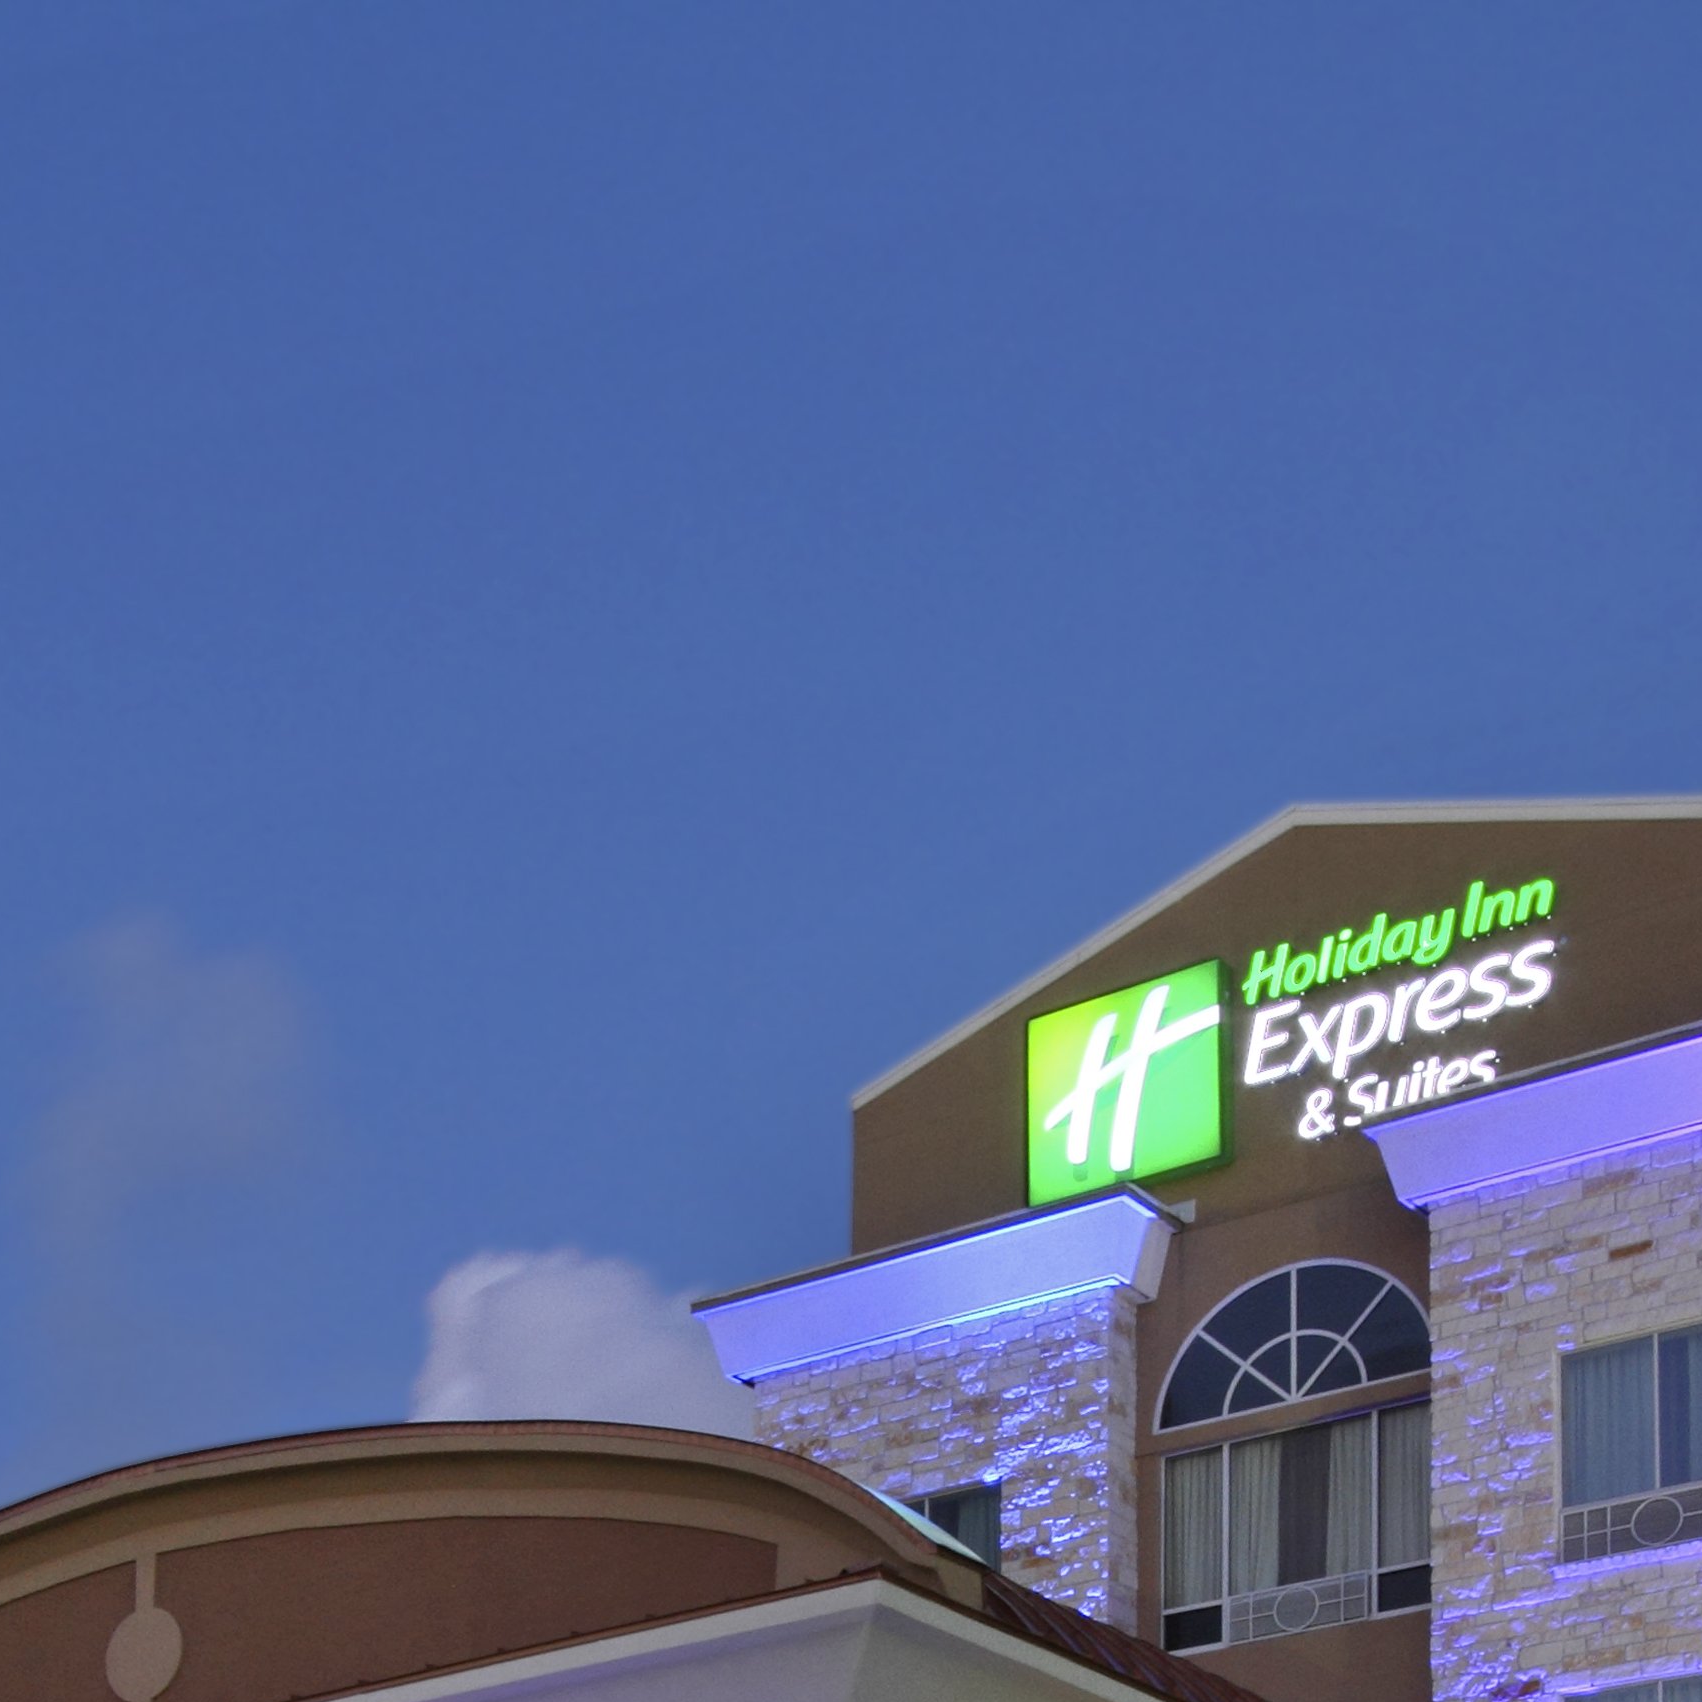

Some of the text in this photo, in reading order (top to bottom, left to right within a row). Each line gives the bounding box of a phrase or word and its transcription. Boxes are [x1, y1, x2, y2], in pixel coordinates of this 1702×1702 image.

[1242, 879, 1554, 1005] Holiday Inn
[1243, 940, 1555, 1085] Express
[1297, 1050, 1498, 1140] & Suites
